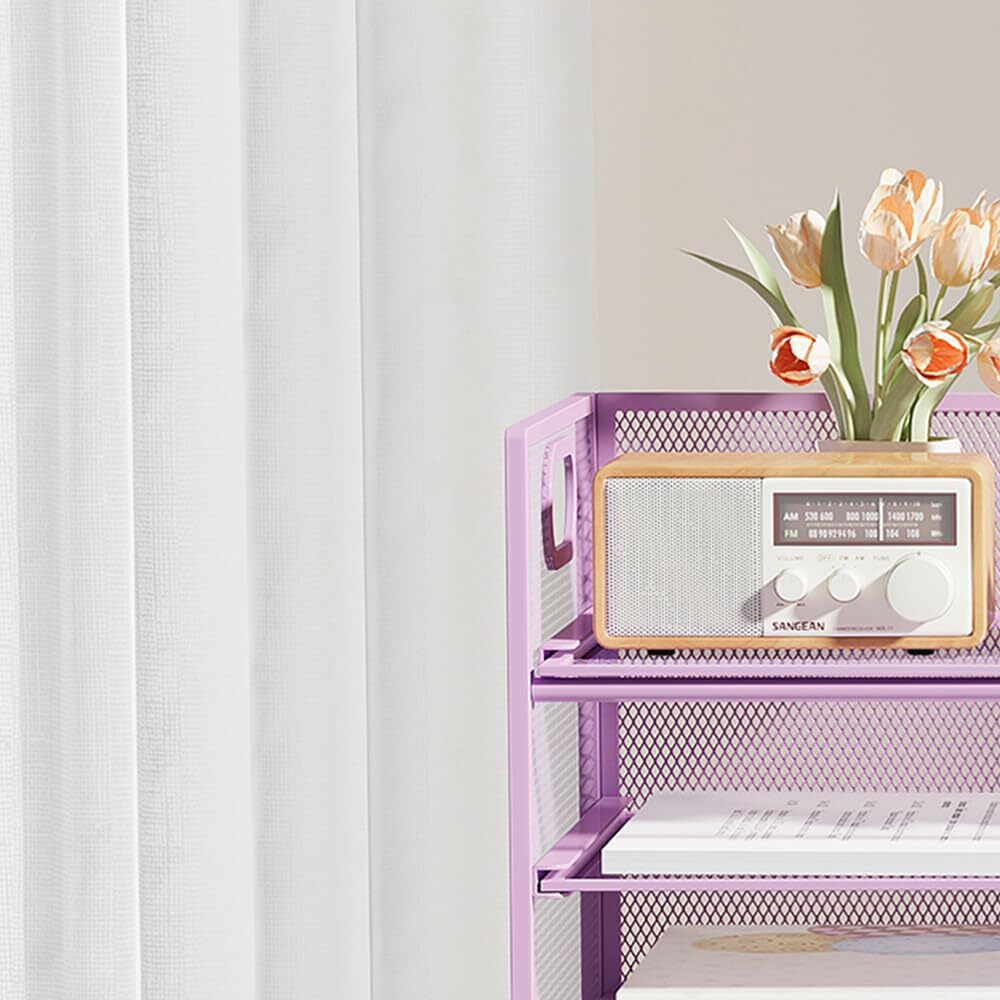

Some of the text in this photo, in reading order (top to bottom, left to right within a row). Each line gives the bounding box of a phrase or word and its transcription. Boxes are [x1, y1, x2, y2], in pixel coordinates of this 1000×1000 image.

[783, 511, 799, 521] AM
[820, 511, 834, 521] 600
[888, 511, 905, 521] 1400
[906, 511, 924, 521] 1700
[784, 528, 799, 538] FM
[885, 528, 899, 538] 104
[772, 621, 825, 631] SANGEAN
